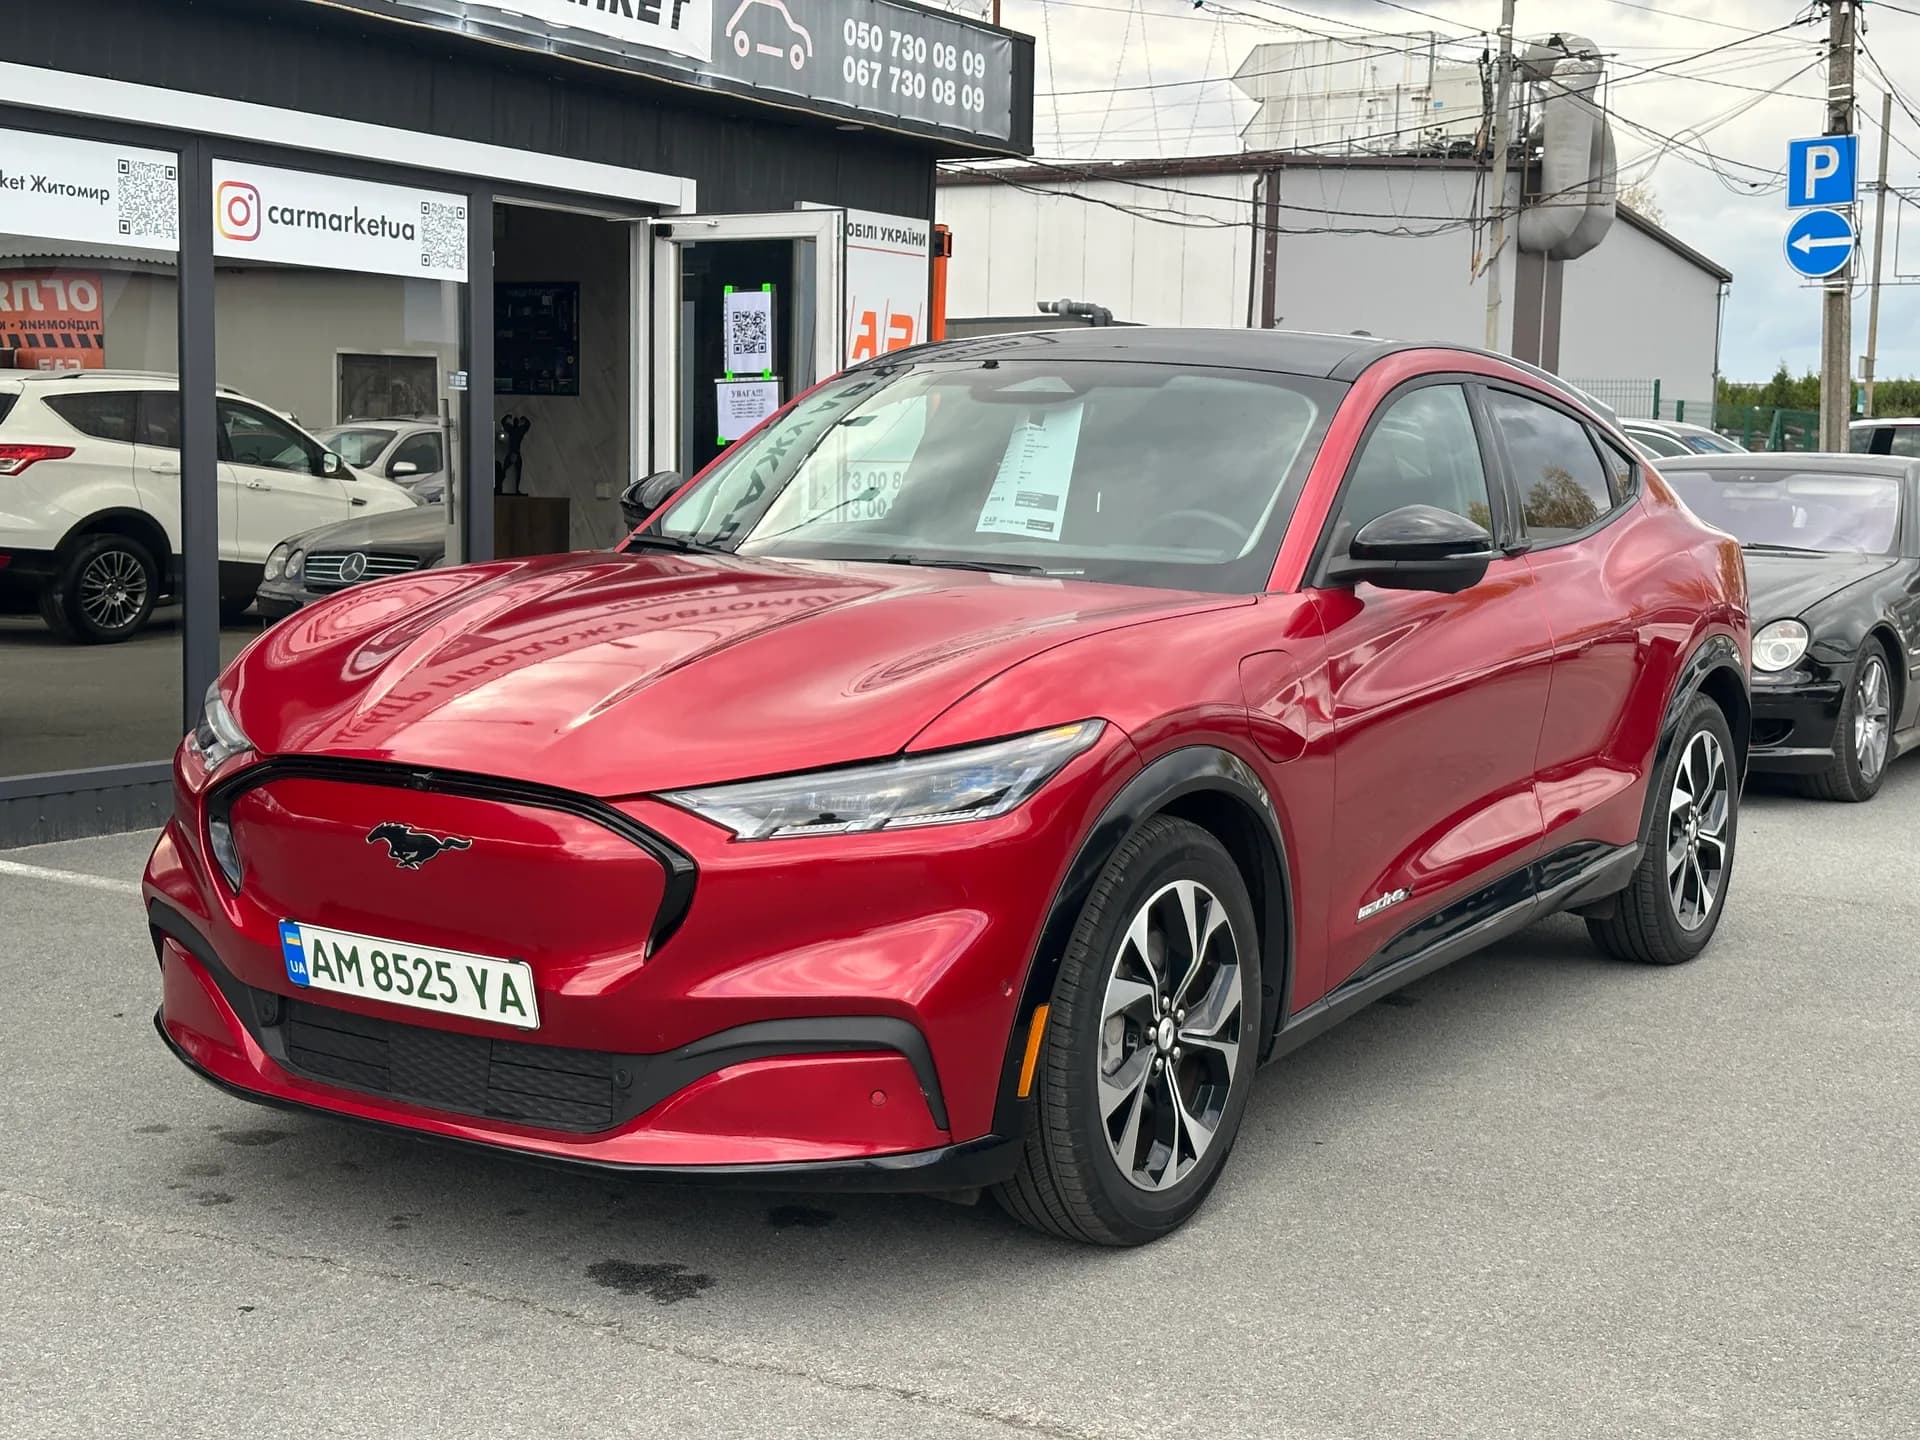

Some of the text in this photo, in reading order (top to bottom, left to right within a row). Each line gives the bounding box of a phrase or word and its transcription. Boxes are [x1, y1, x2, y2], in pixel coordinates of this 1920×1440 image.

[843, 18, 986, 79] 050 730 08 09
[843, 55, 985, 113] 067 730 08 09
[0, 169, 110, 205] ket Житомир
[1805, 145, 1839, 200] P
[268, 205, 415, 240] carmarketua
[880, 226, 926, 247] УКРАЇНИ
[289, 960, 306, 975] UA
[312, 938, 365, 988] AM
[370, 950, 459, 1003] 8525
